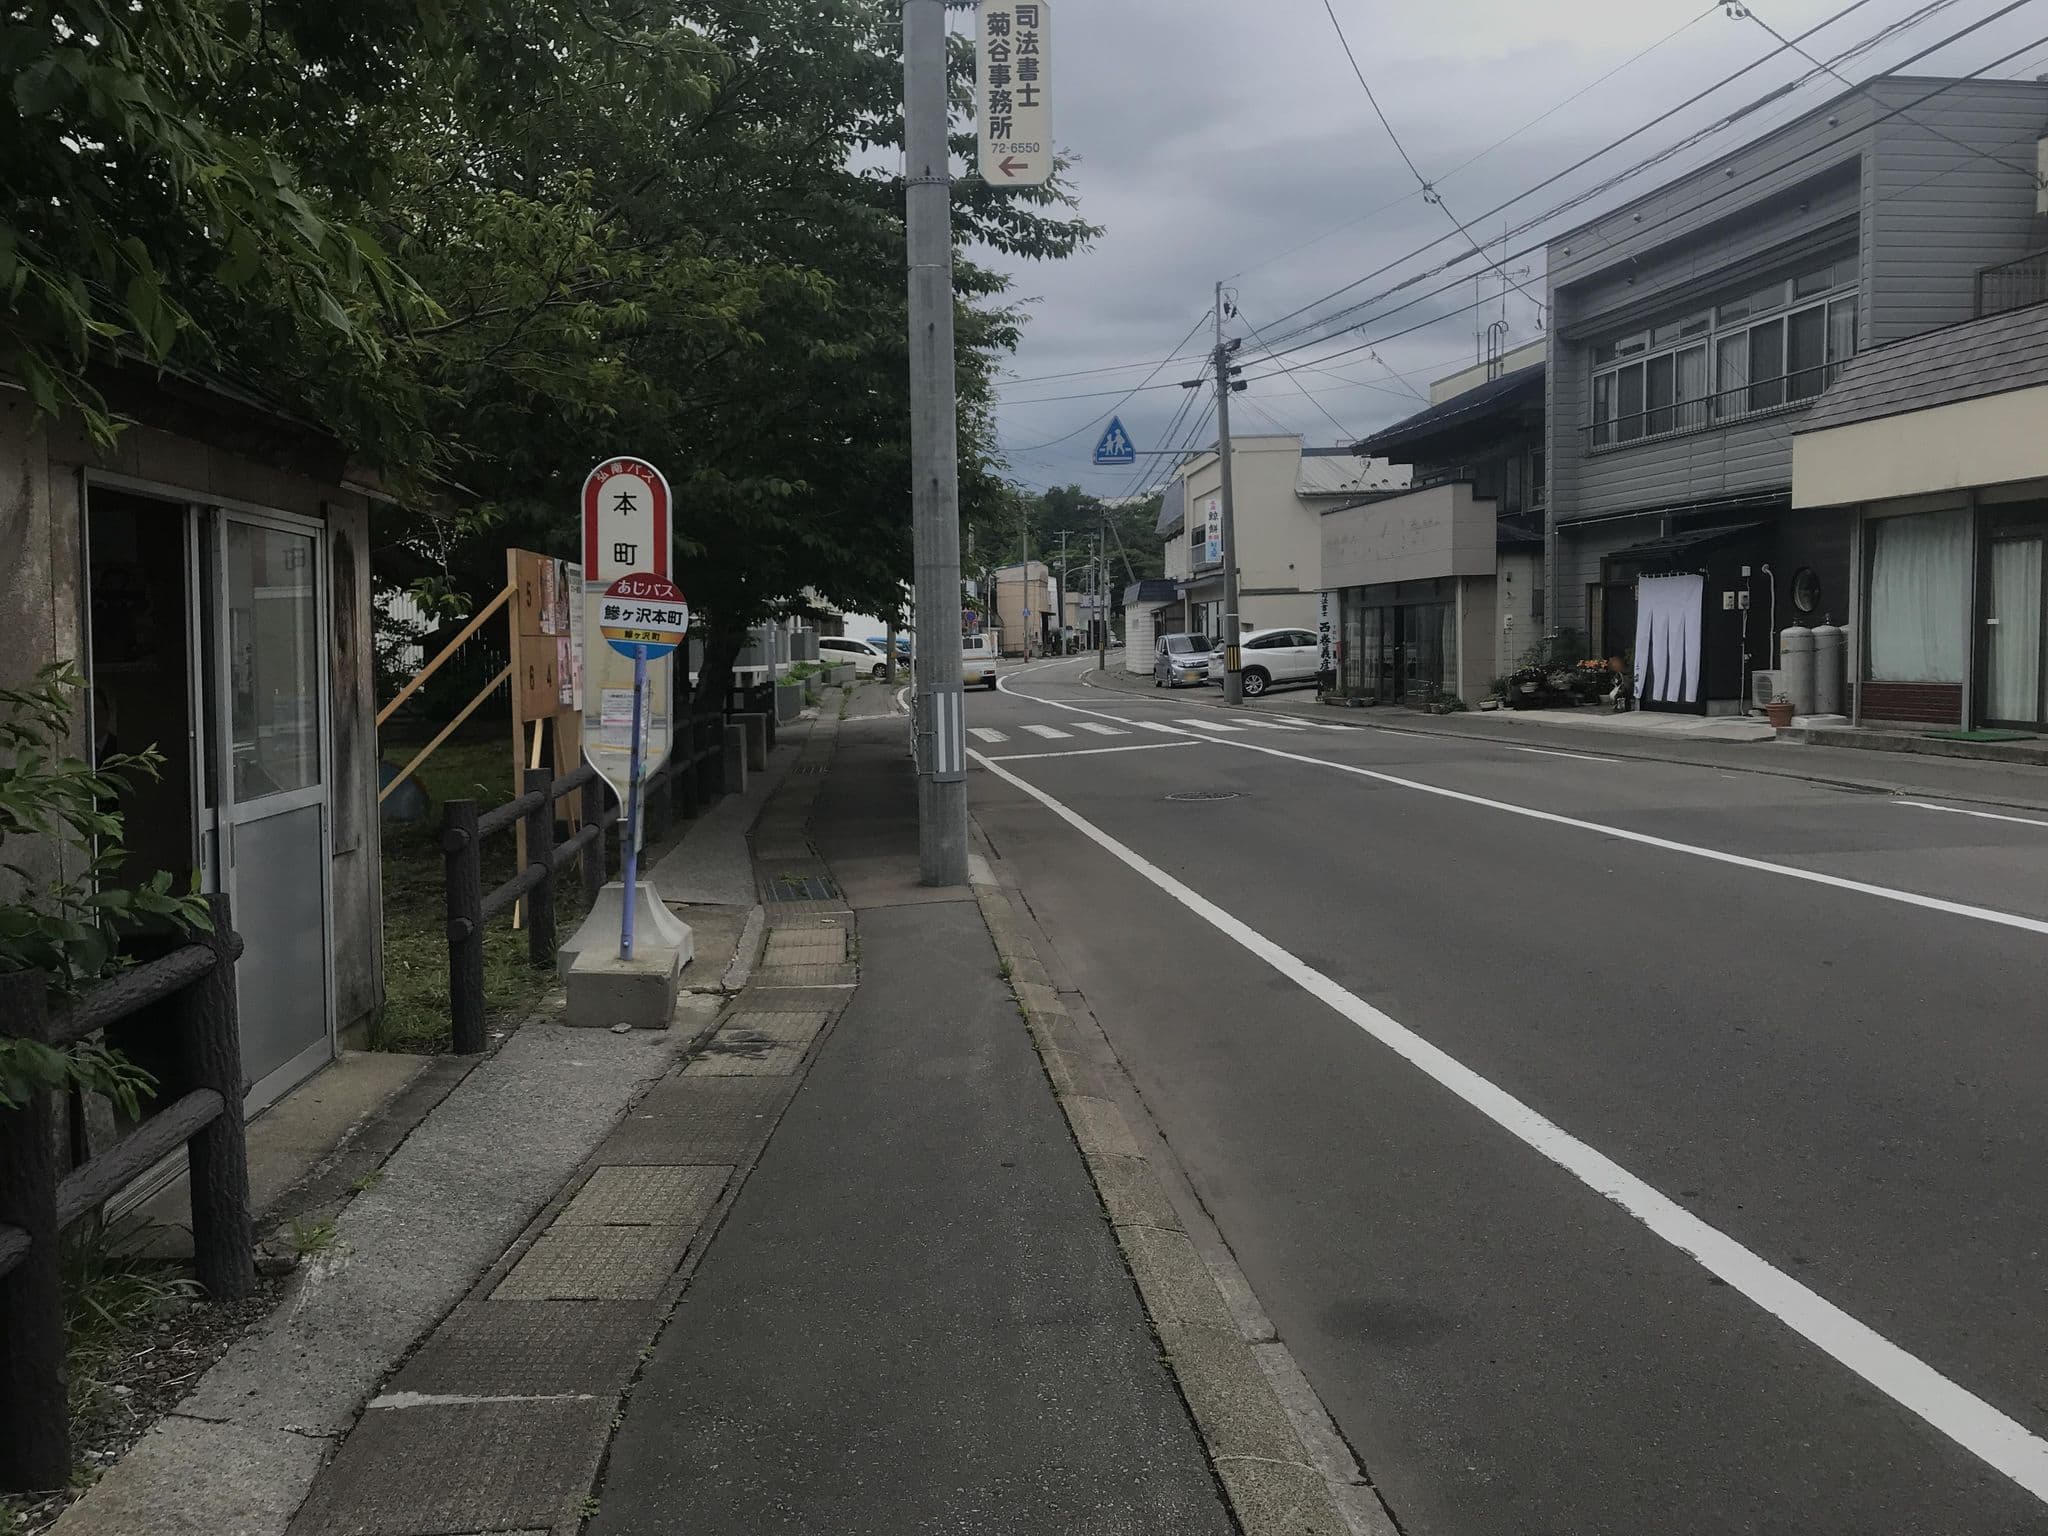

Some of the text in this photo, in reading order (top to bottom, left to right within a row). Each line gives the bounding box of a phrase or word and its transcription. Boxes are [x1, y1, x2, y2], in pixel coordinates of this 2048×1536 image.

[987, 11, 1013, 140] 菊谷事務所
[1015, 4, 1040, 108] 司法書士
[613, 491, 638, 565] 本町
[526, 581, 532, 607] 5
[618, 580, 674, 597] あじバス
